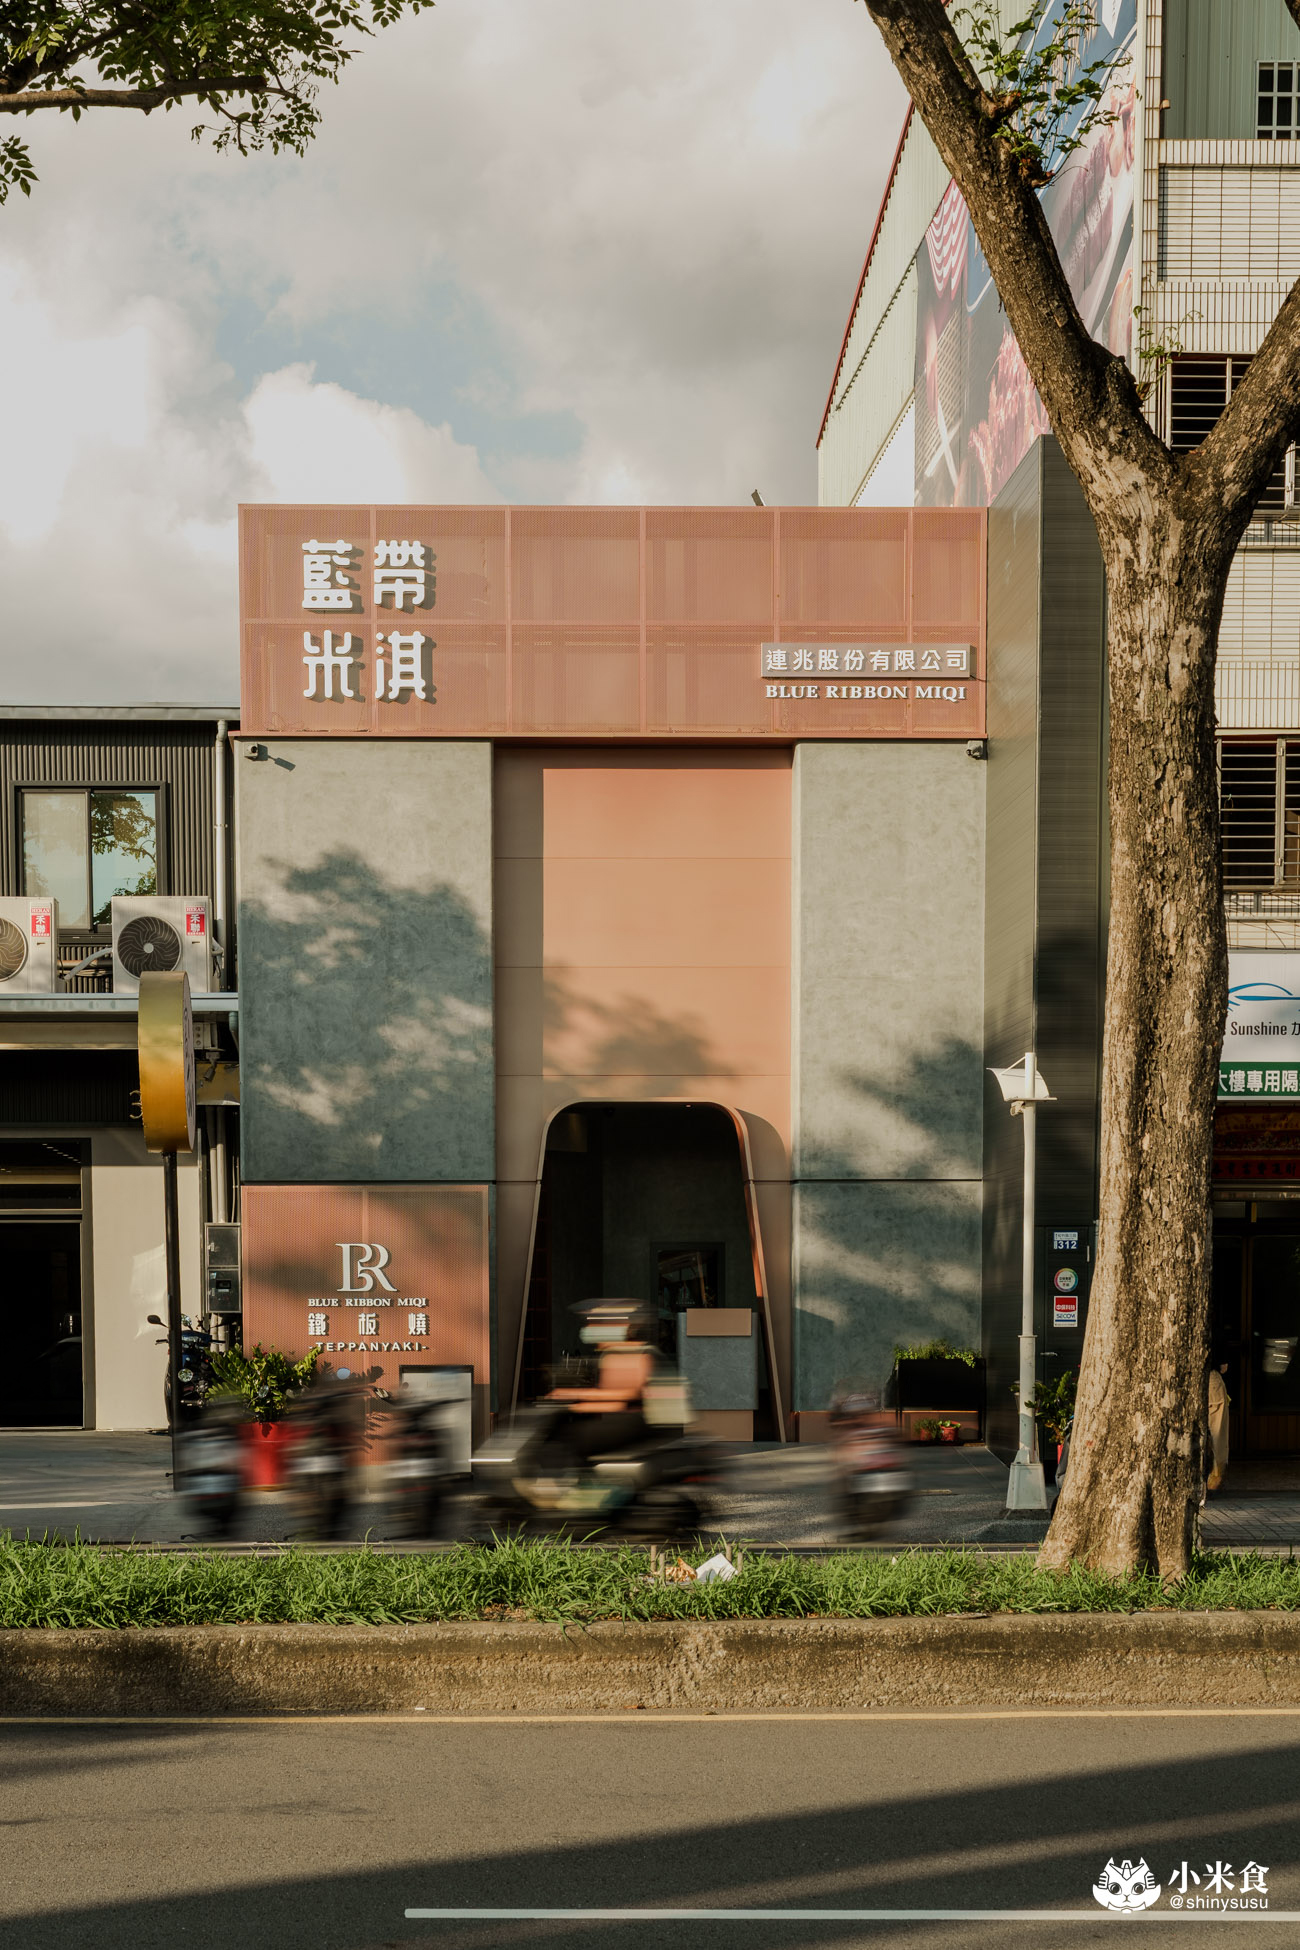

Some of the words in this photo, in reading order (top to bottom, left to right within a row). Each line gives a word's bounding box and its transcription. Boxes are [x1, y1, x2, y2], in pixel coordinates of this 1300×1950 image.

[302, 629, 426, 700] 米淇
[766, 649, 968, 671] 連兆股份有限公司
[765, 685, 818, 699] BLUE
[825, 685, 908, 699] RIBBON
[915, 685, 966, 702] MIQI
[1230, 1021, 1288, 1036] Sunshine
[1219, 1069, 1300, 1093] 樓專用隔
[1058, 1240, 1077, 1249] 312
[307, 1298, 339, 1307] BLUE
[345, 1298, 391, 1307] RIBBON
[397, 1297, 427, 1308] MIQI
[308, 1312, 427, 1335] 鐵板燒
